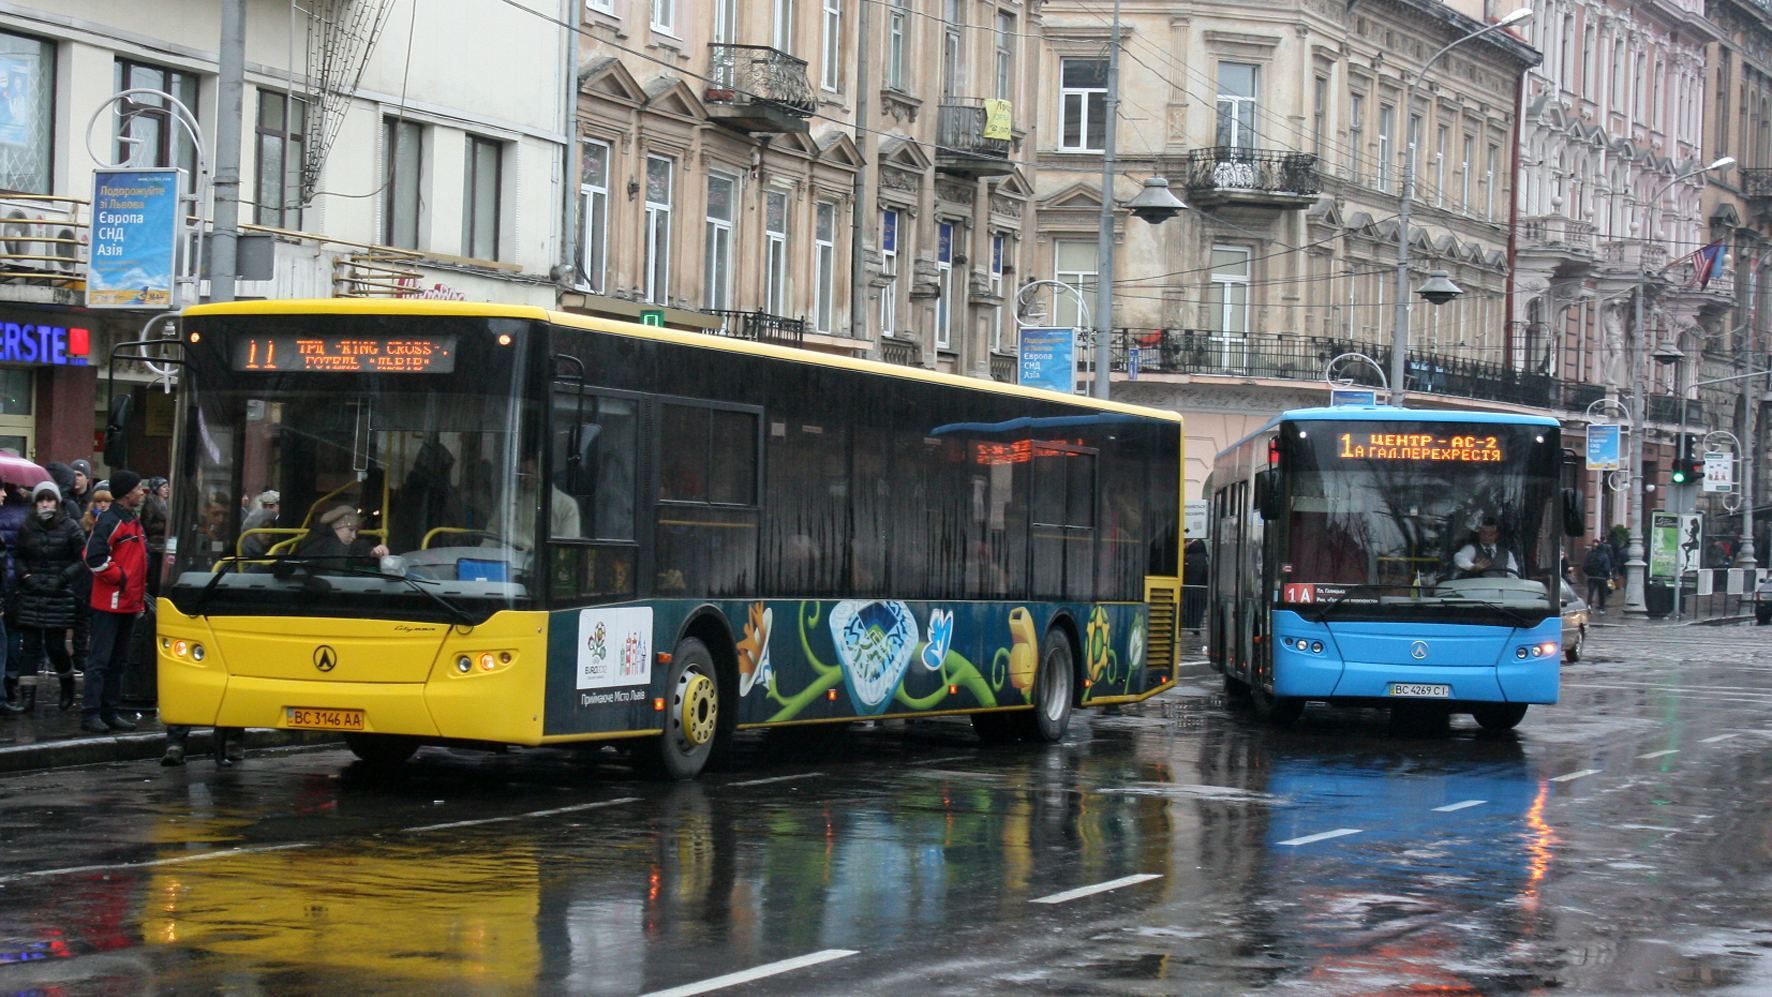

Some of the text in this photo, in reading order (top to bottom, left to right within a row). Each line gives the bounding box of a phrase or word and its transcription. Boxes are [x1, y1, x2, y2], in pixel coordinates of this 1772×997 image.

[99, 211, 144, 226] Європа
[98, 227, 124, 242] СНД
[97, 243, 123, 256] Азія
[1024, 361, 1040, 370] СНД
[1371, 434, 1432, 447] ЦЕНТР
[1451, 436, 1497, 449] АС-2
[1411, 685, 1432, 695] 4269
[581, 689, 646, 708] Приймаюче Місто Львів
[314, 711, 341, 726] 3146
[344, 712, 361, 727] AA
